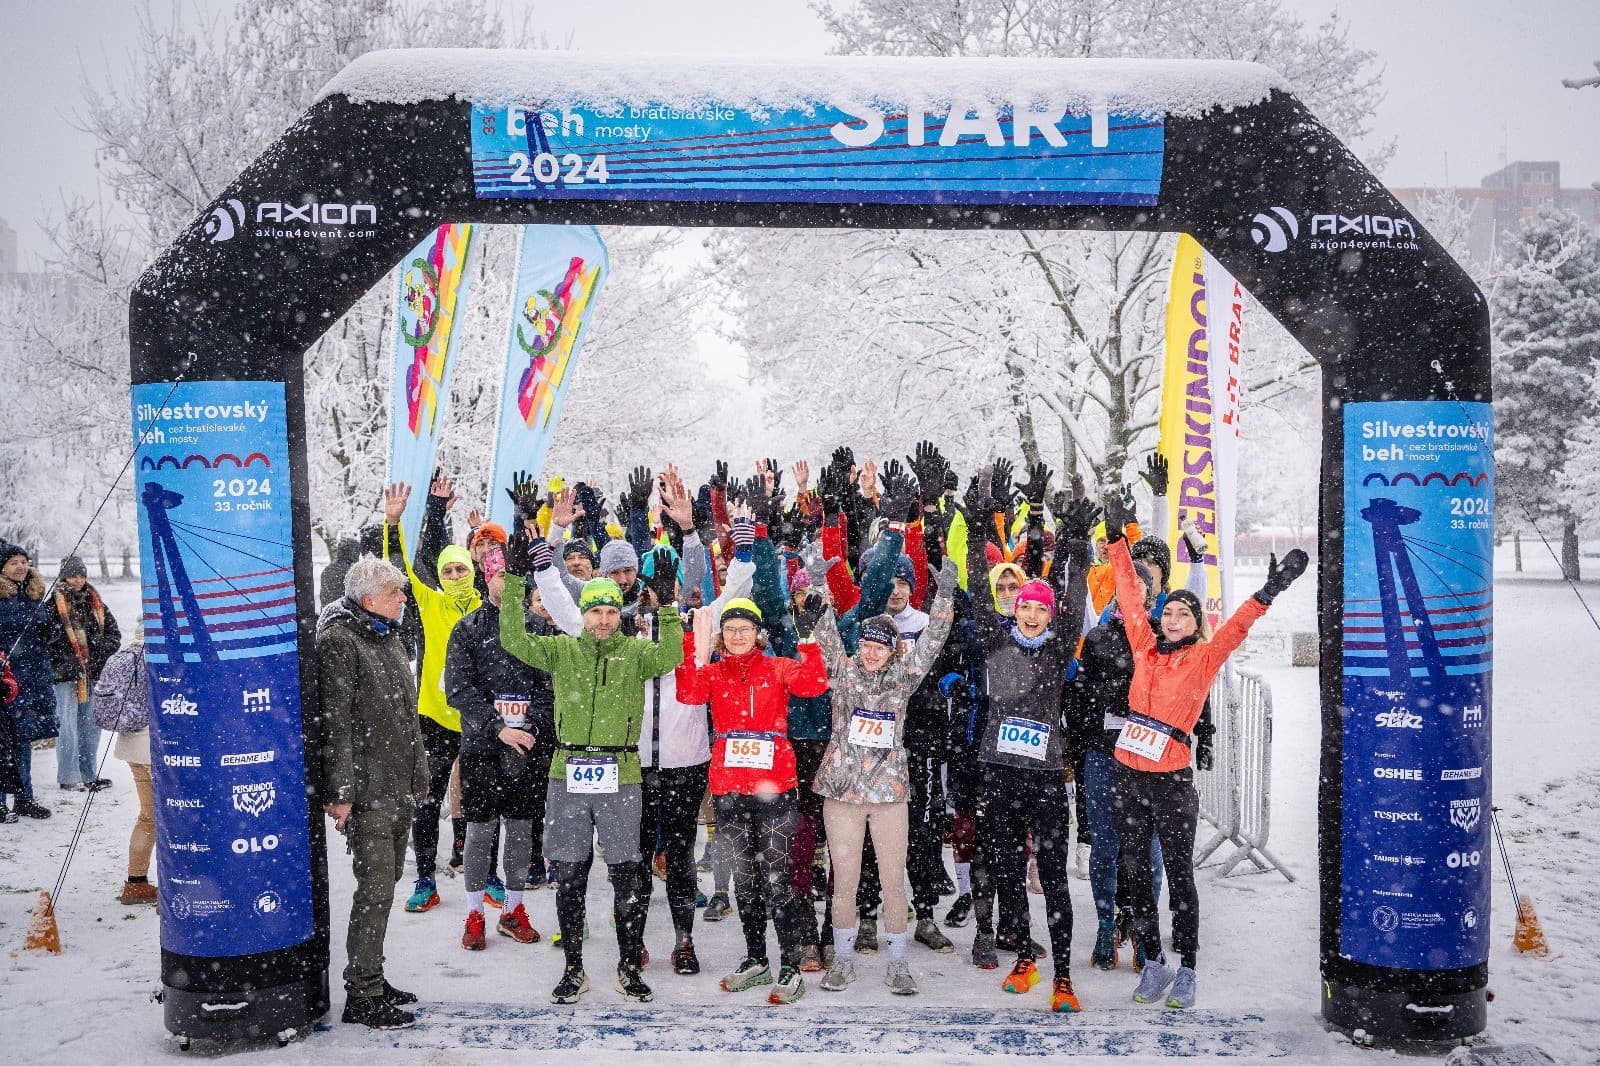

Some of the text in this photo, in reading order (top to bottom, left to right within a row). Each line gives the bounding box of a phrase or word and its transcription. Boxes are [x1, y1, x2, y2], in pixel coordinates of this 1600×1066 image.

[507, 104, 584, 136] beh
[830, 98, 1111, 148] START
[595, 124, 652, 143] mosty
[508, 152, 610, 184] 2024
[256, 202, 377, 225] AXION
[255, 228, 375, 238] axion4event.com
[1311, 214, 1416, 239] AXION
[1310, 240, 1419, 250] axion4event.com
[137, 400, 269, 423] Silvestrovský
[138, 427, 165, 445] beh
[169, 435, 199, 444] mosty
[1362, 420, 1490, 443] Silvestrovský
[1362, 444, 1404, 462] beh
[1409, 453, 1441, 463] mosty
[212, 478, 272, 498] 2024
[214, 501, 234, 512] 33.
[1450, 519, 1467, 529] 33.
[857, 718, 883, 736] 776
[1124, 723, 1158, 747] 1071
[1001, 726, 1041, 748] 1046
[731, 740, 761, 756] 565
[163, 755, 201, 767] OSHEE
[573, 766, 605, 781] 649
[1373, 767, 1423, 780] OSHEE
[1374, 810, 1423, 822] respect.
[231, 834, 279, 854] OLO
[1446, 850, 1480, 868] OLO
